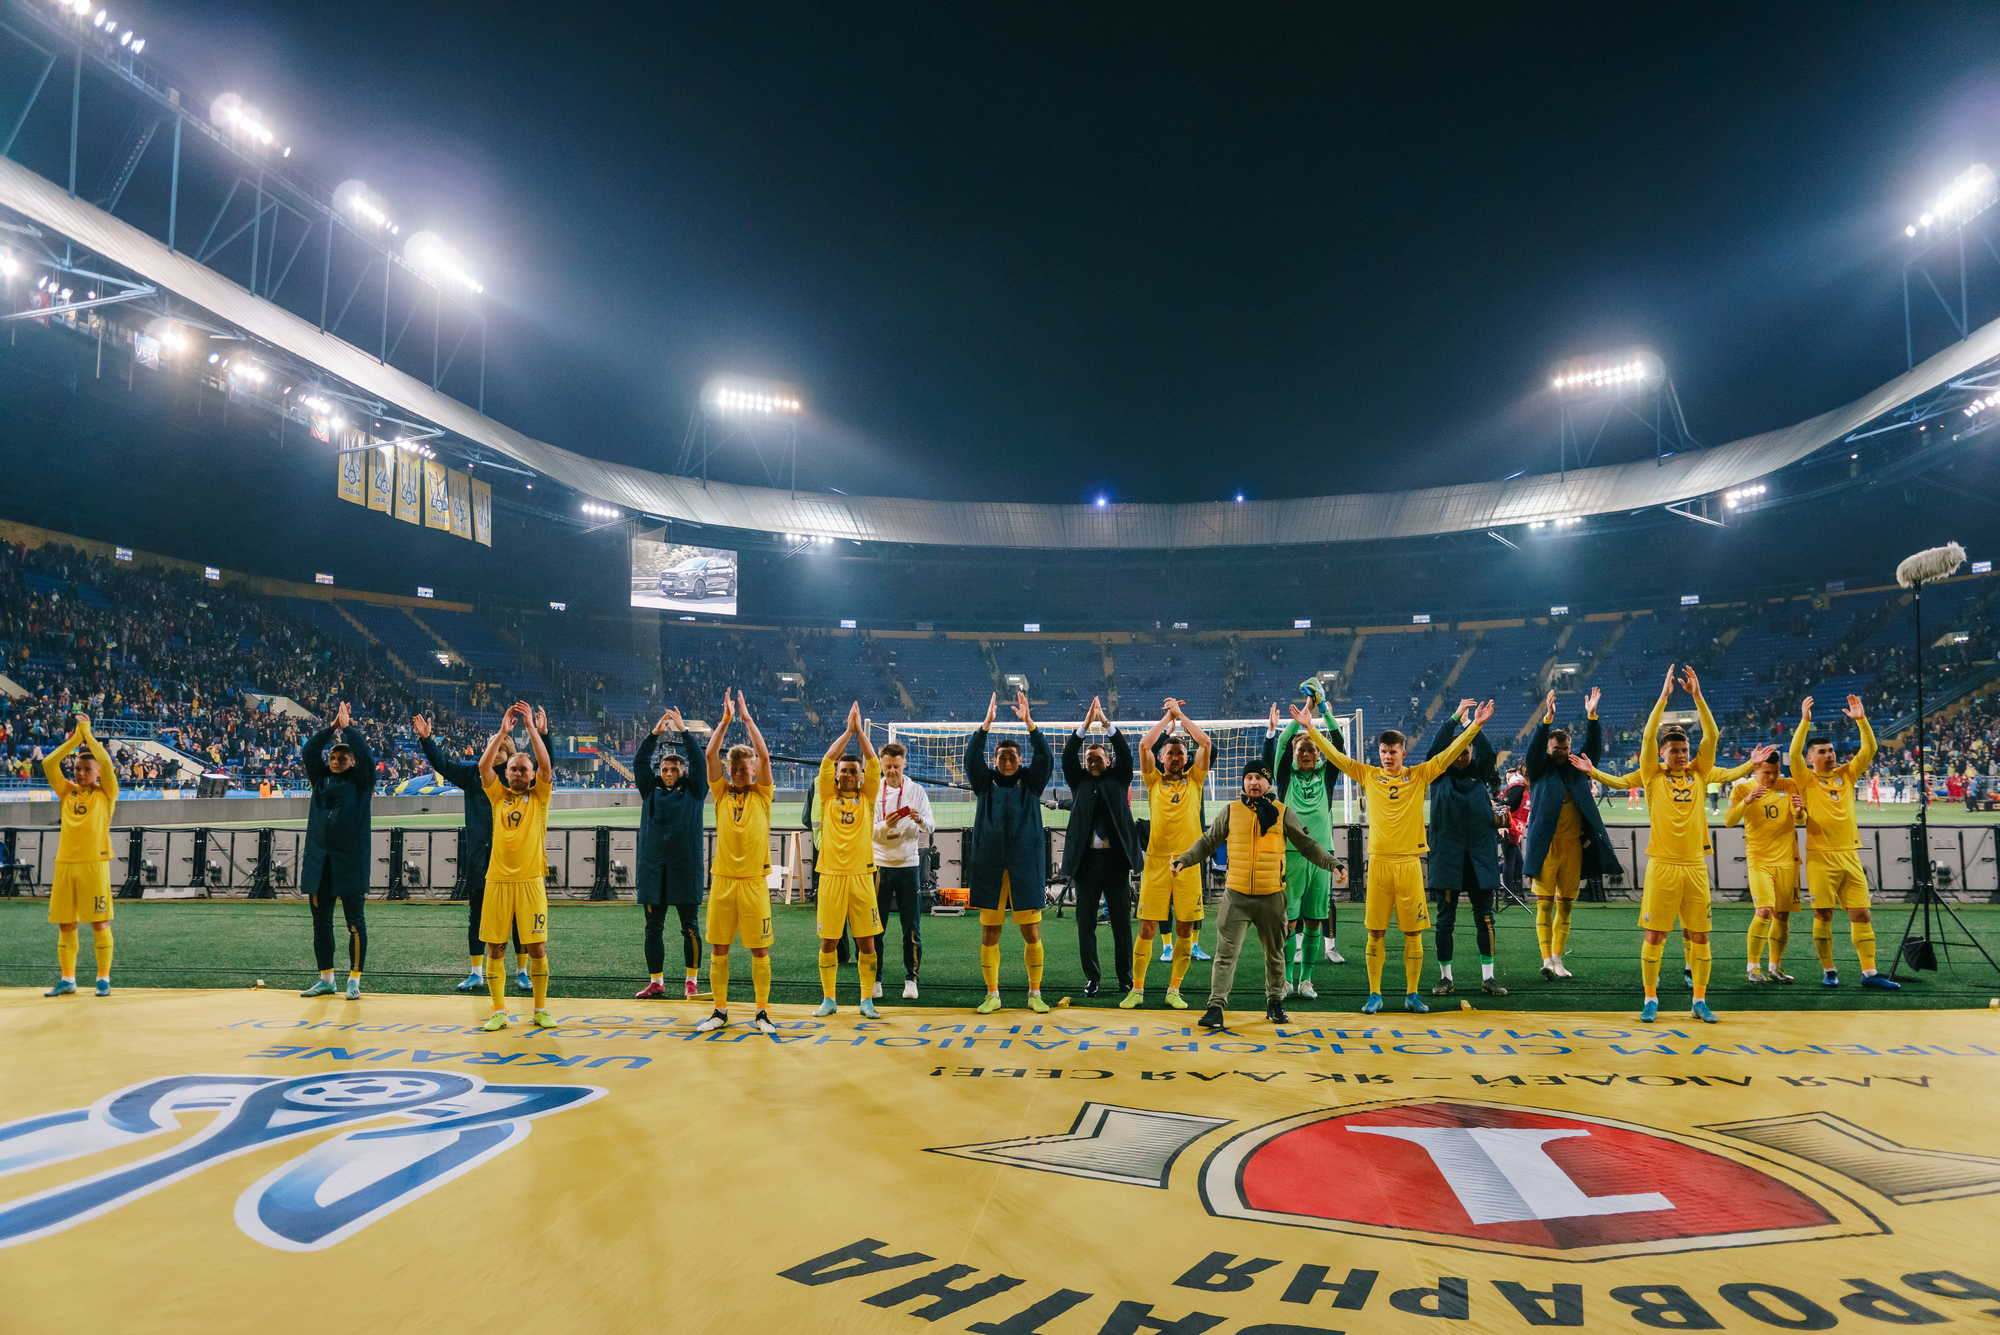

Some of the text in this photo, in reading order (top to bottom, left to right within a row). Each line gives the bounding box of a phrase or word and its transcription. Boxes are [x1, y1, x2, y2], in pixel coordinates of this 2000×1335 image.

[1170, 793, 1180, 804] 4
[1388, 785, 1400, 800] 2
[1672, 788, 1692, 802] 22
[507, 810, 522, 828] 19
[733, 807, 744, 822] 17
[1763, 804, 1779, 819] 10
[533, 913, 546, 930] 19
[762, 917, 771, 935] 17
[920, 1023, 1244, 1038] УКРАЇНИ
[1275, 1027, 1691, 1039] КОМАНДИ
[512, 1026, 1128, 1052] НАЦІОНАЛЬНОЇ
[246, 1045, 653, 1069] UKRAINE
[929, 1066, 1115, 1080] СЕБЕ!
[1140, 1070, 1287, 1082] ДЛЯ
[1304, 1072, 1395, 1084] ЯК
[1470, 1072, 1752, 1088] ЛЮДЕЙ
[1777, 1074, 1934, 1088] ДЛЯ
[775, 1237, 1346, 1335] АТНА
